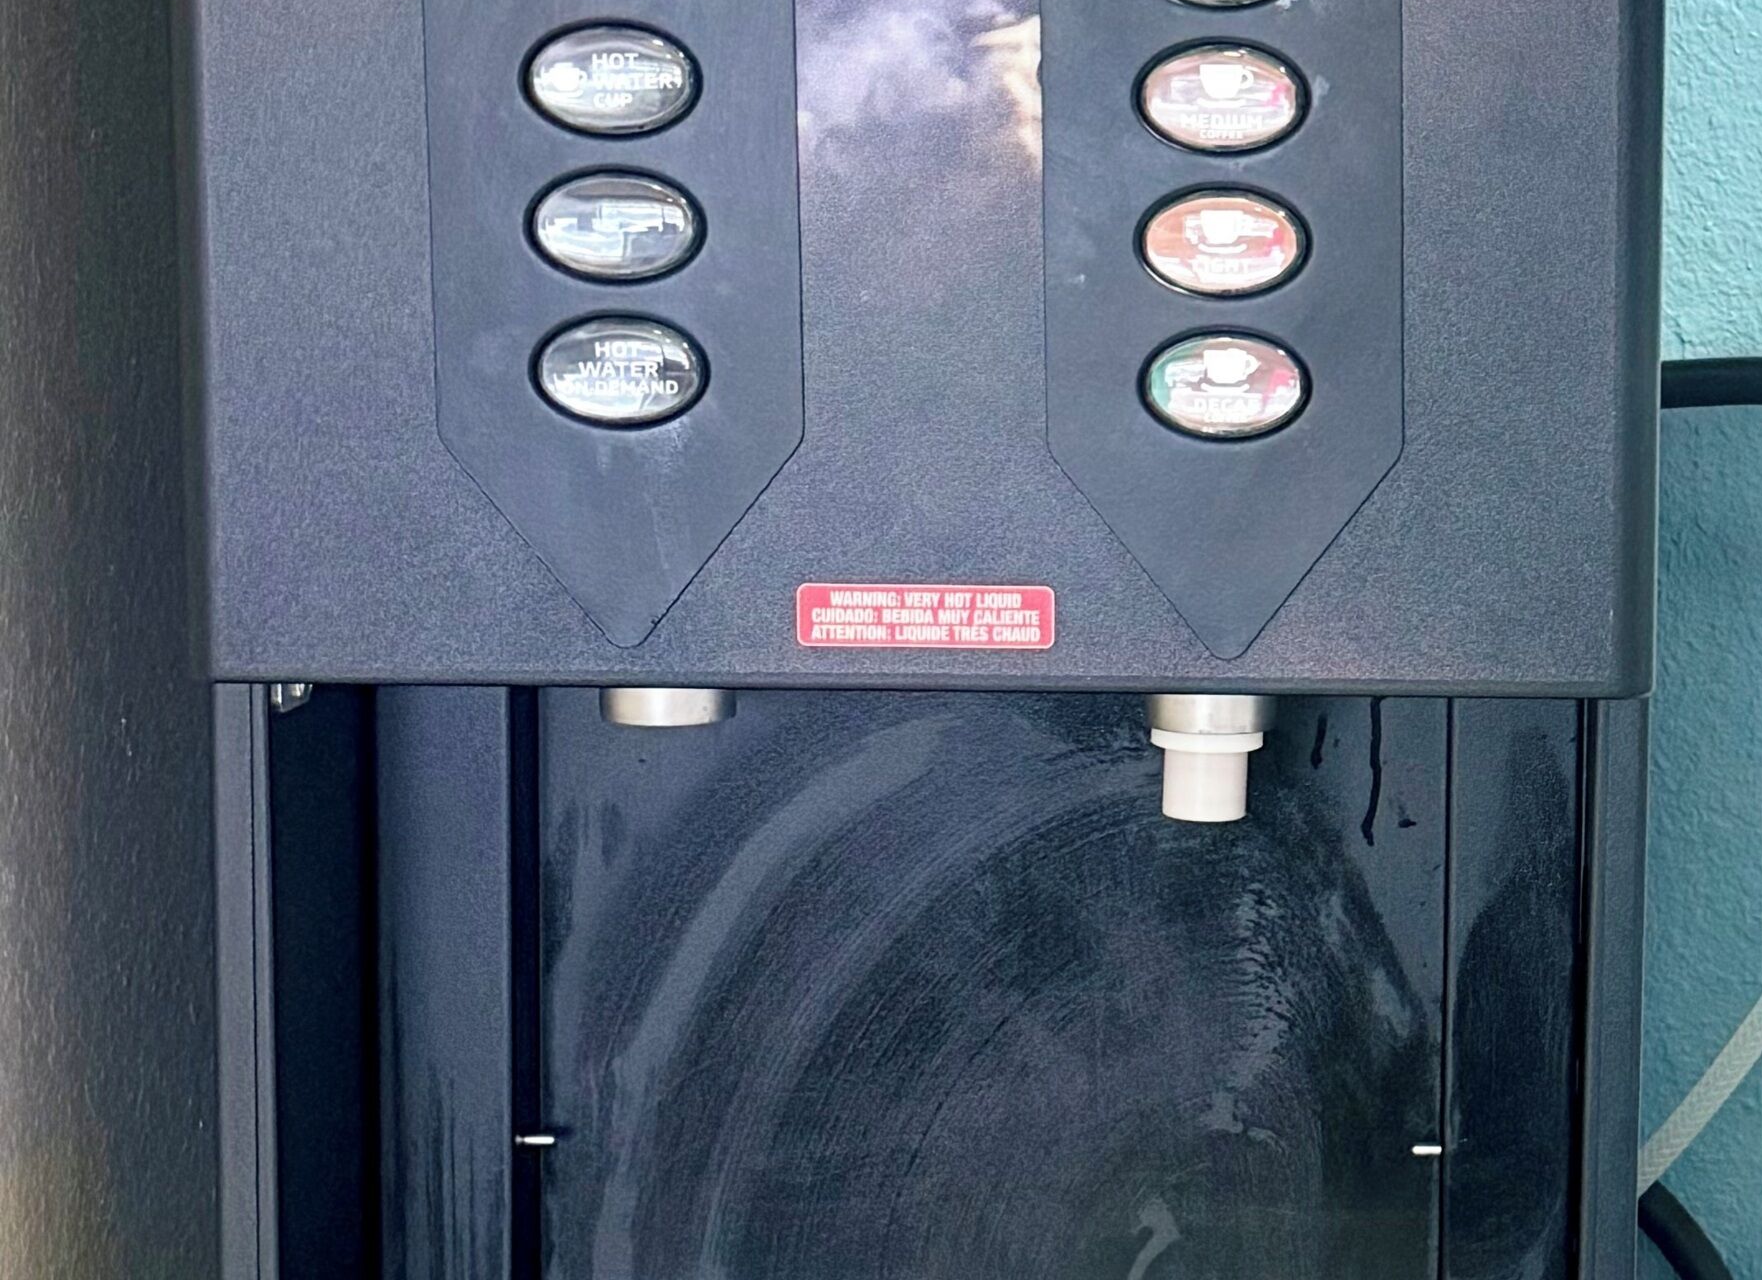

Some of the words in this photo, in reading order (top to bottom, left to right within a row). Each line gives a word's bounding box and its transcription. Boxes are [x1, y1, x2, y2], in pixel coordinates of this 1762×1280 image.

[592, 53, 639, 70] HOT
[592, 72, 676, 89] WATER
[593, 92, 633, 108] CUP
[595, 341, 640, 358] HOT
[578, 361, 658, 378] WATER
[830, 590, 901, 608] WARNING:
[904, 591, 941, 608] VERY
[944, 592, 972, 608] HOT
[976, 592, 1022, 609] LIQUID
[812, 607, 879, 624] CUIDADO:
[883, 608, 935, 625] BEBIDA
[938, 609, 969, 625] MUY
[973, 610, 1040, 626] CALIENTE
[811, 625, 891, 641] ATTENTION:
[895, 626, 950, 641] LIQUIDE
[993, 626, 1041, 642] CHAUD
